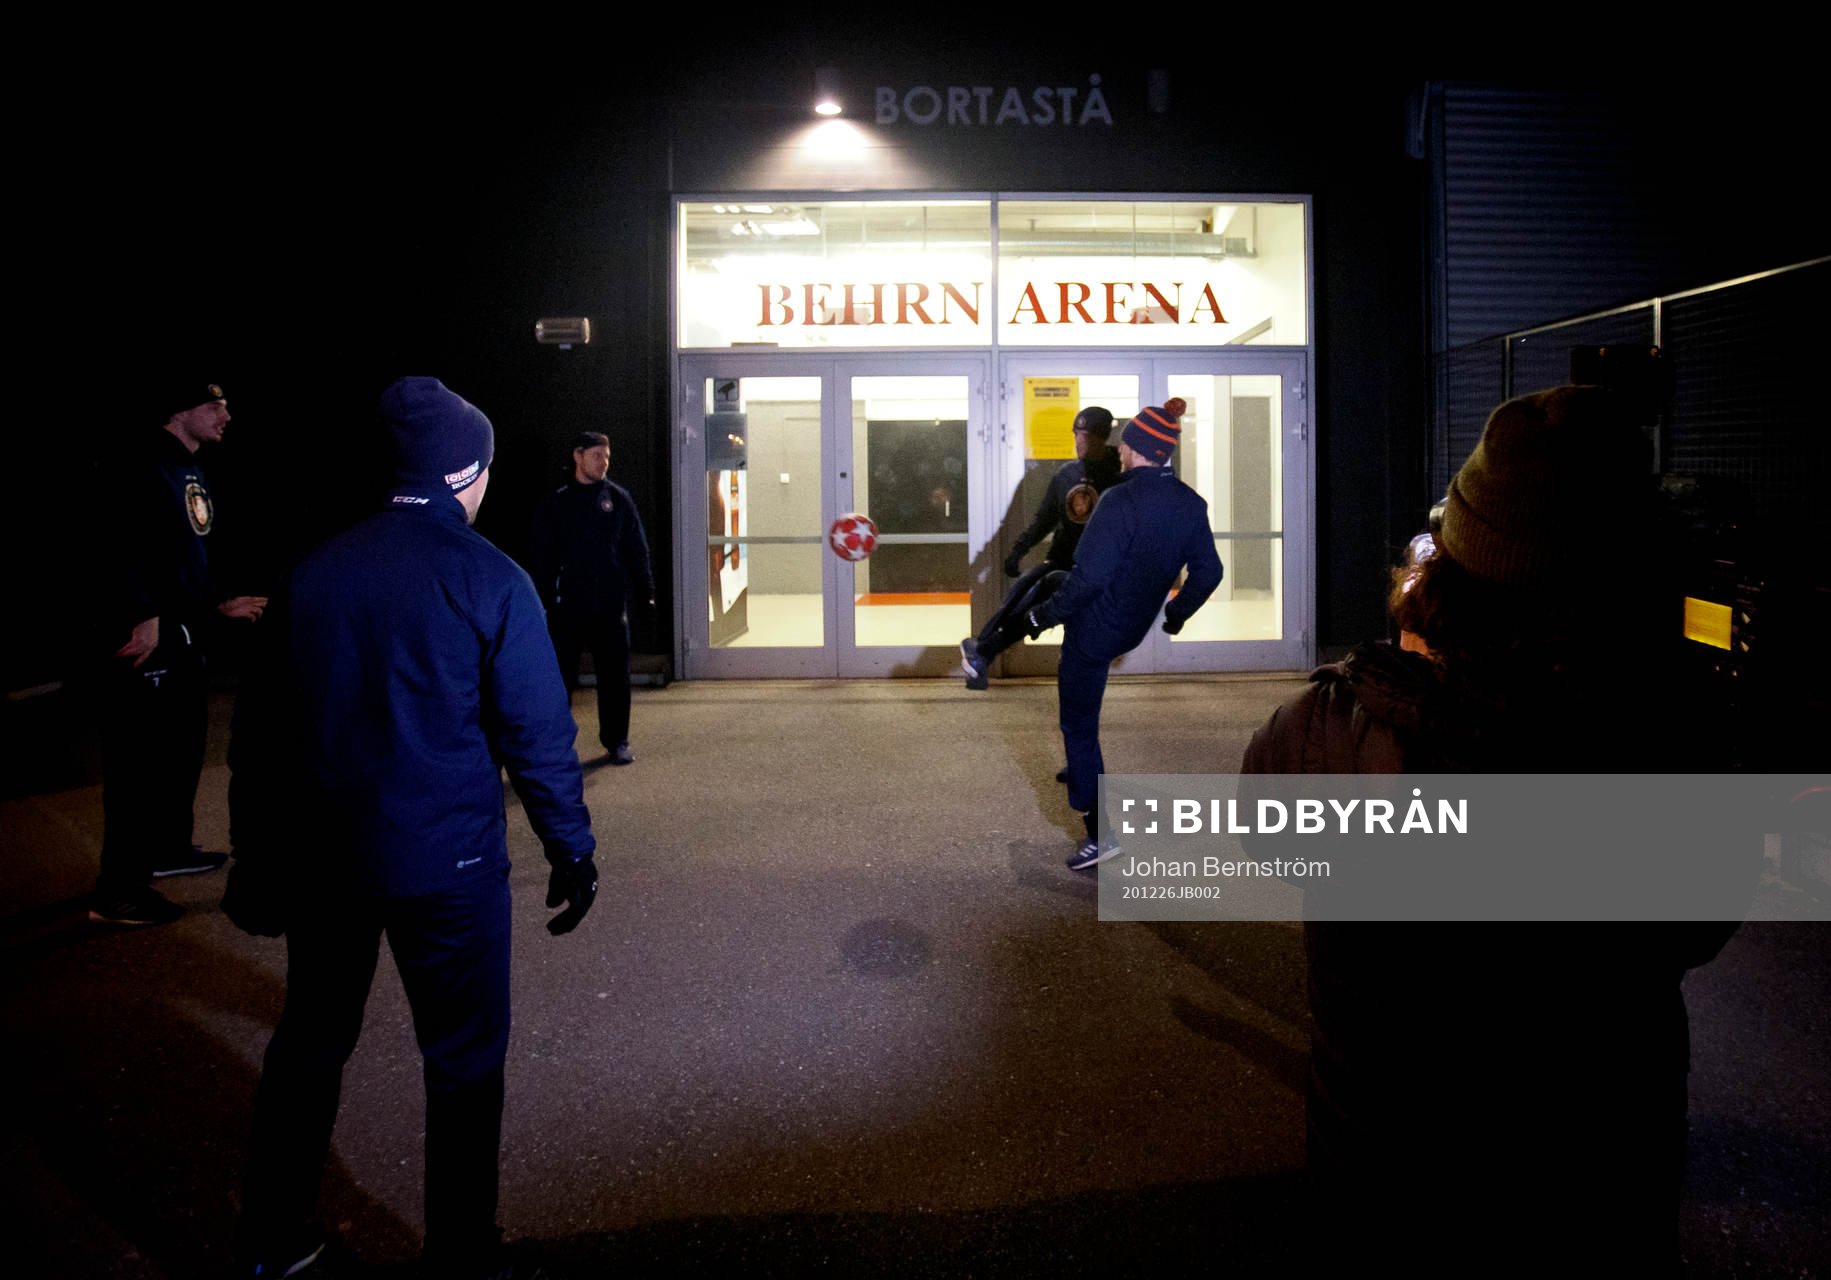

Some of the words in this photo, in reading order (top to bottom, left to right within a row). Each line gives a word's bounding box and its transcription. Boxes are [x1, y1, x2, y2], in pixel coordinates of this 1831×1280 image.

[875, 73, 1115, 127] BORTASTÅ
[757, 282, 984, 327] BEHRN
[1009, 282, 1229, 325] ARENA
[392, 496, 430, 504] CCM
